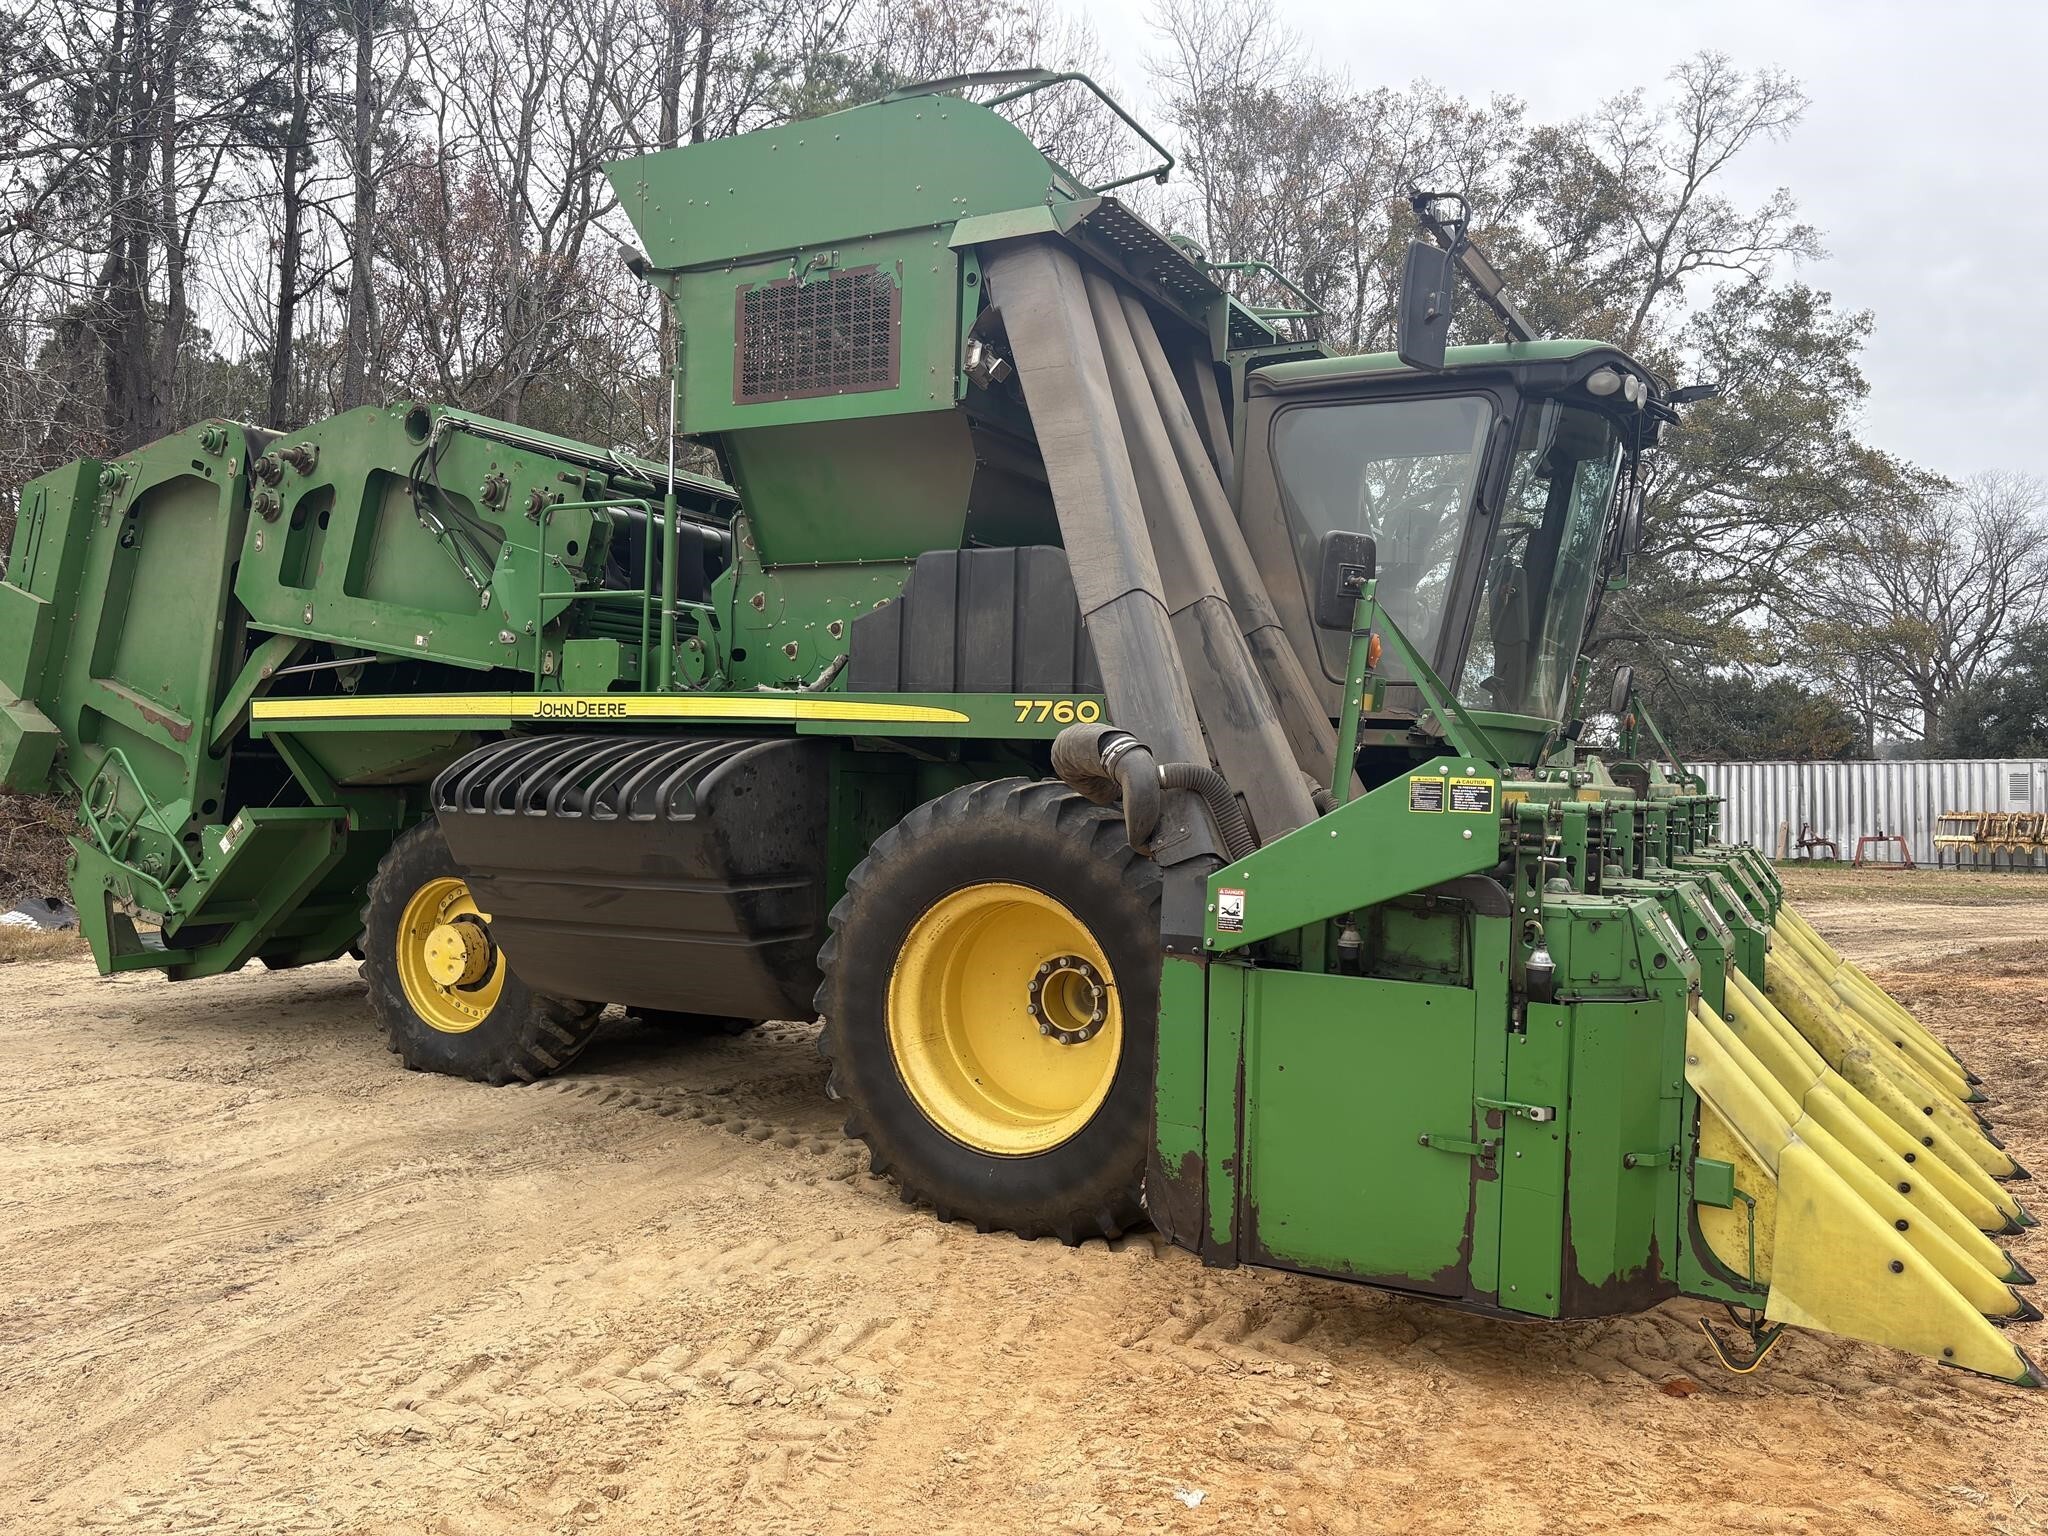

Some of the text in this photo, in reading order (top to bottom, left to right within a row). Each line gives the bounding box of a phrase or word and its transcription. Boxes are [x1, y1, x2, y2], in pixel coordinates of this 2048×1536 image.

[534, 700, 627, 715] JOHN DEERE
[1014, 700, 1100, 724] 7760
